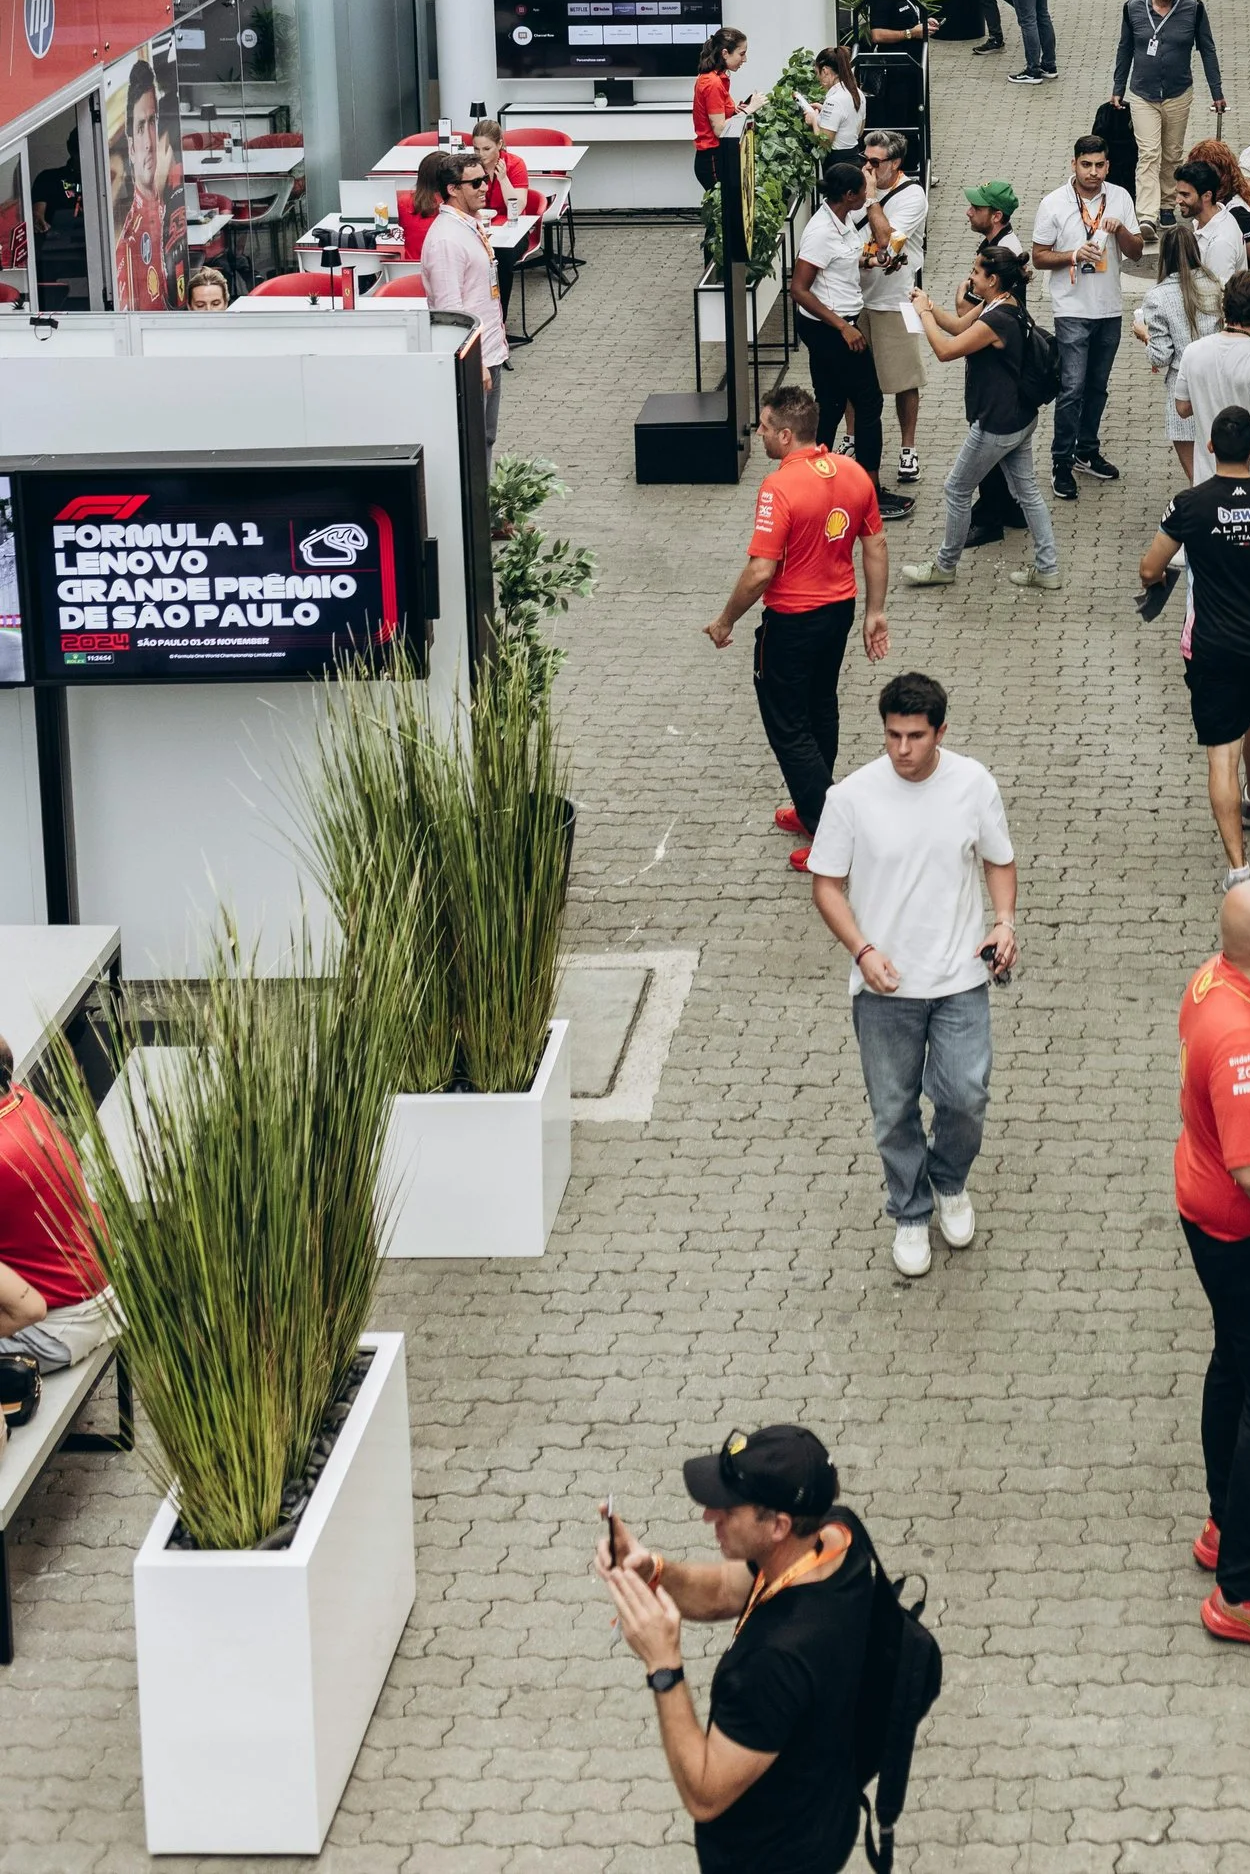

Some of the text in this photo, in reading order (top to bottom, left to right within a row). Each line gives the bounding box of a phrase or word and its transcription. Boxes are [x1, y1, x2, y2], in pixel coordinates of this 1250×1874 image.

[53, 522, 264, 549] FORMULA 1
[54, 549, 208, 576] LENOVO
[57, 573, 357, 603] GRANDE PRÊMIO
[59, 601, 320, 630] DE SÃO PAULO
[61, 633, 270, 651] 2024 SÃO PAULO 01-03 NOVEMBER
